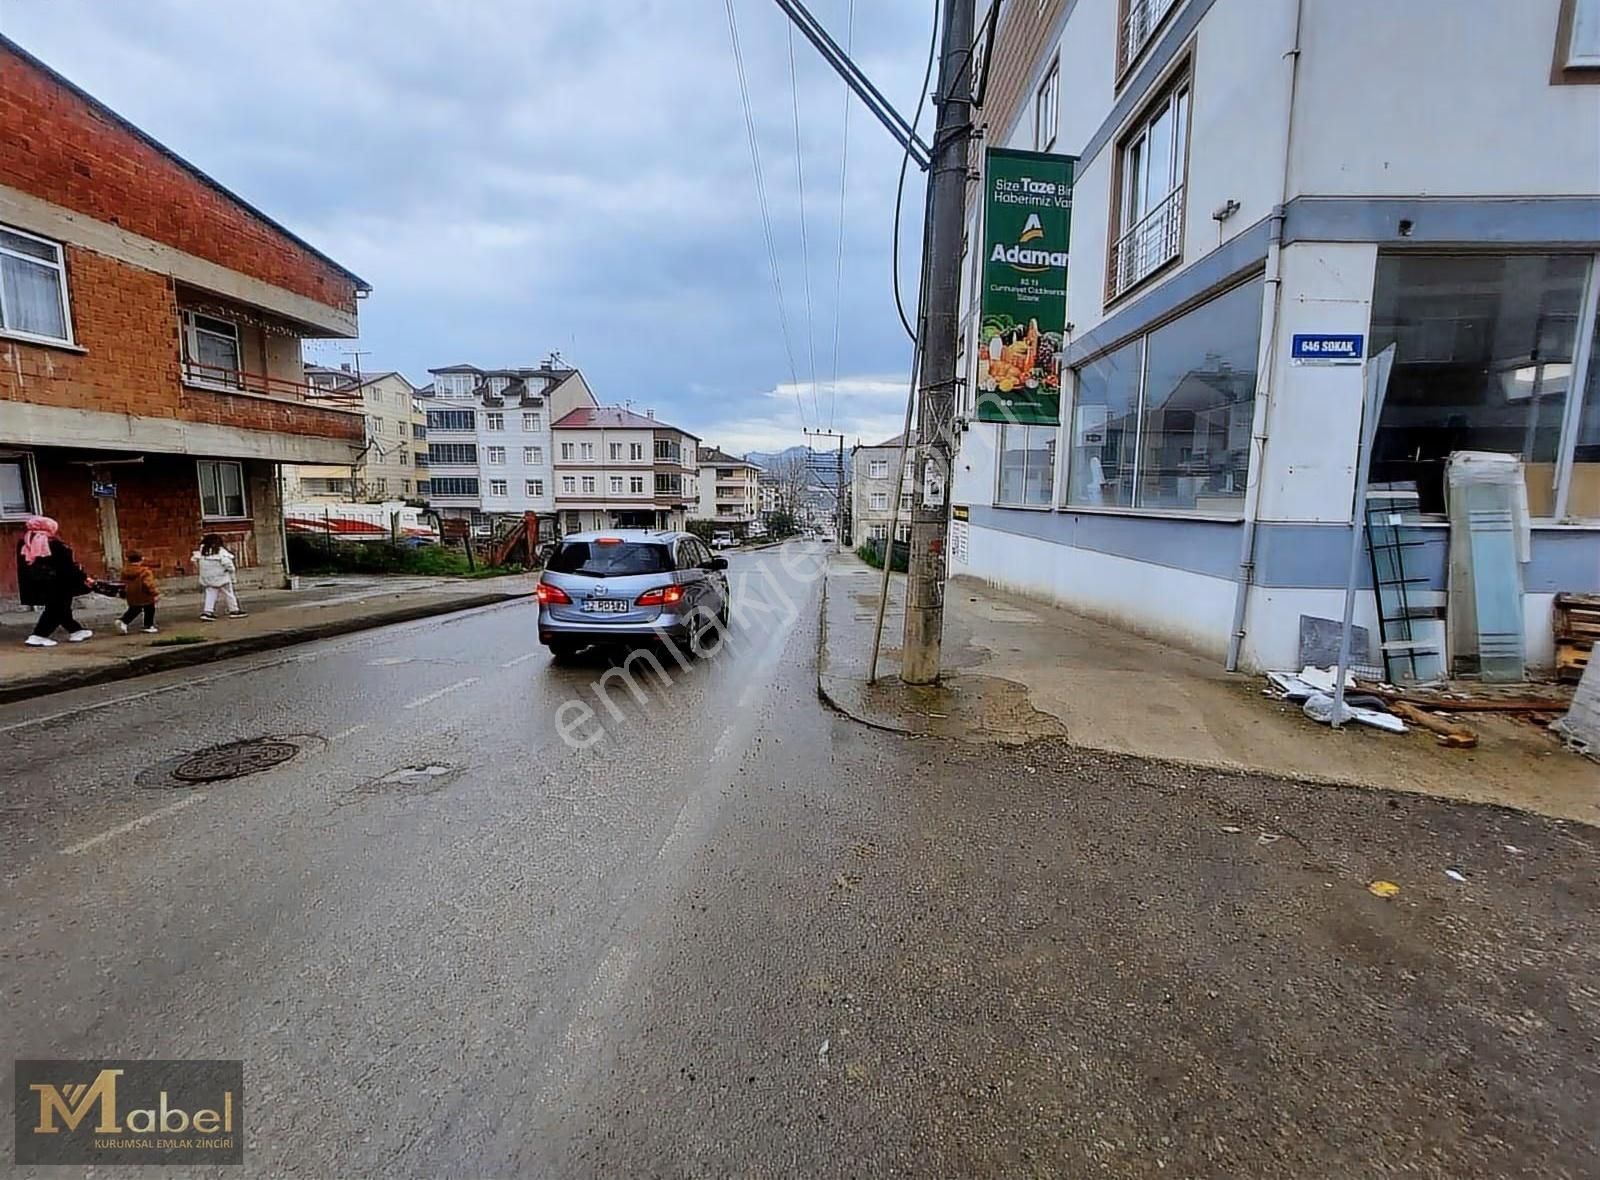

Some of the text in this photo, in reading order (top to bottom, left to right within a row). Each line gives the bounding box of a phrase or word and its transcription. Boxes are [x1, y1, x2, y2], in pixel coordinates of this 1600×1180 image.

[995, 178, 1020, 192] Size
[1020, 177, 1057, 195] Taze
[994, 190, 1073, 208] Haberimiz Var
[1301, 340, 1354, 352] 646 SOKAK
